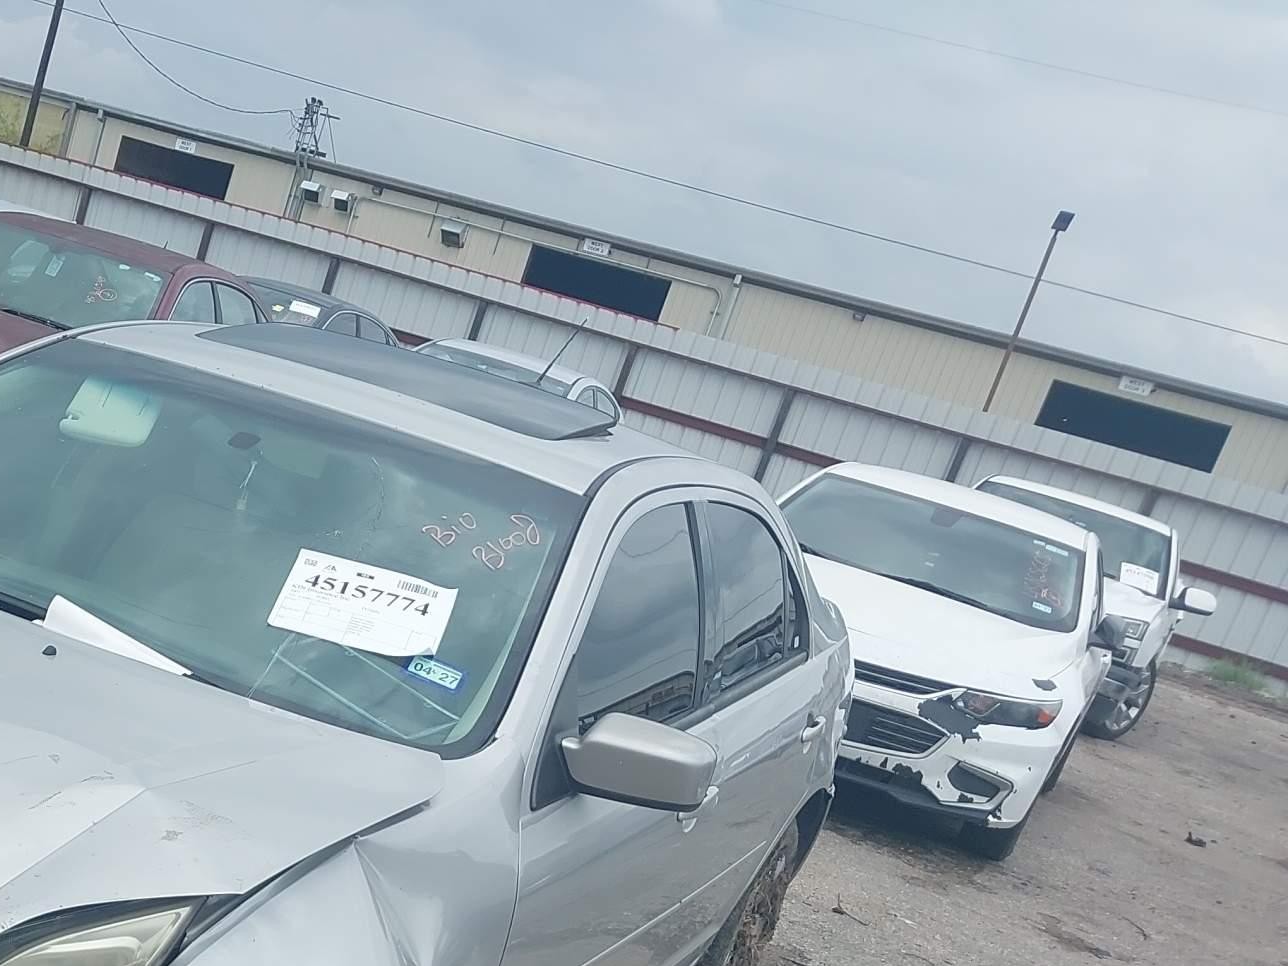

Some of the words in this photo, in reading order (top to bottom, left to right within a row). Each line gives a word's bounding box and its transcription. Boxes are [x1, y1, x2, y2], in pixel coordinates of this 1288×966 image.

[304, 574, 431, 617] 45157774
[414, 662, 432, 675] 04
[438, 672, 459, 685] 27
